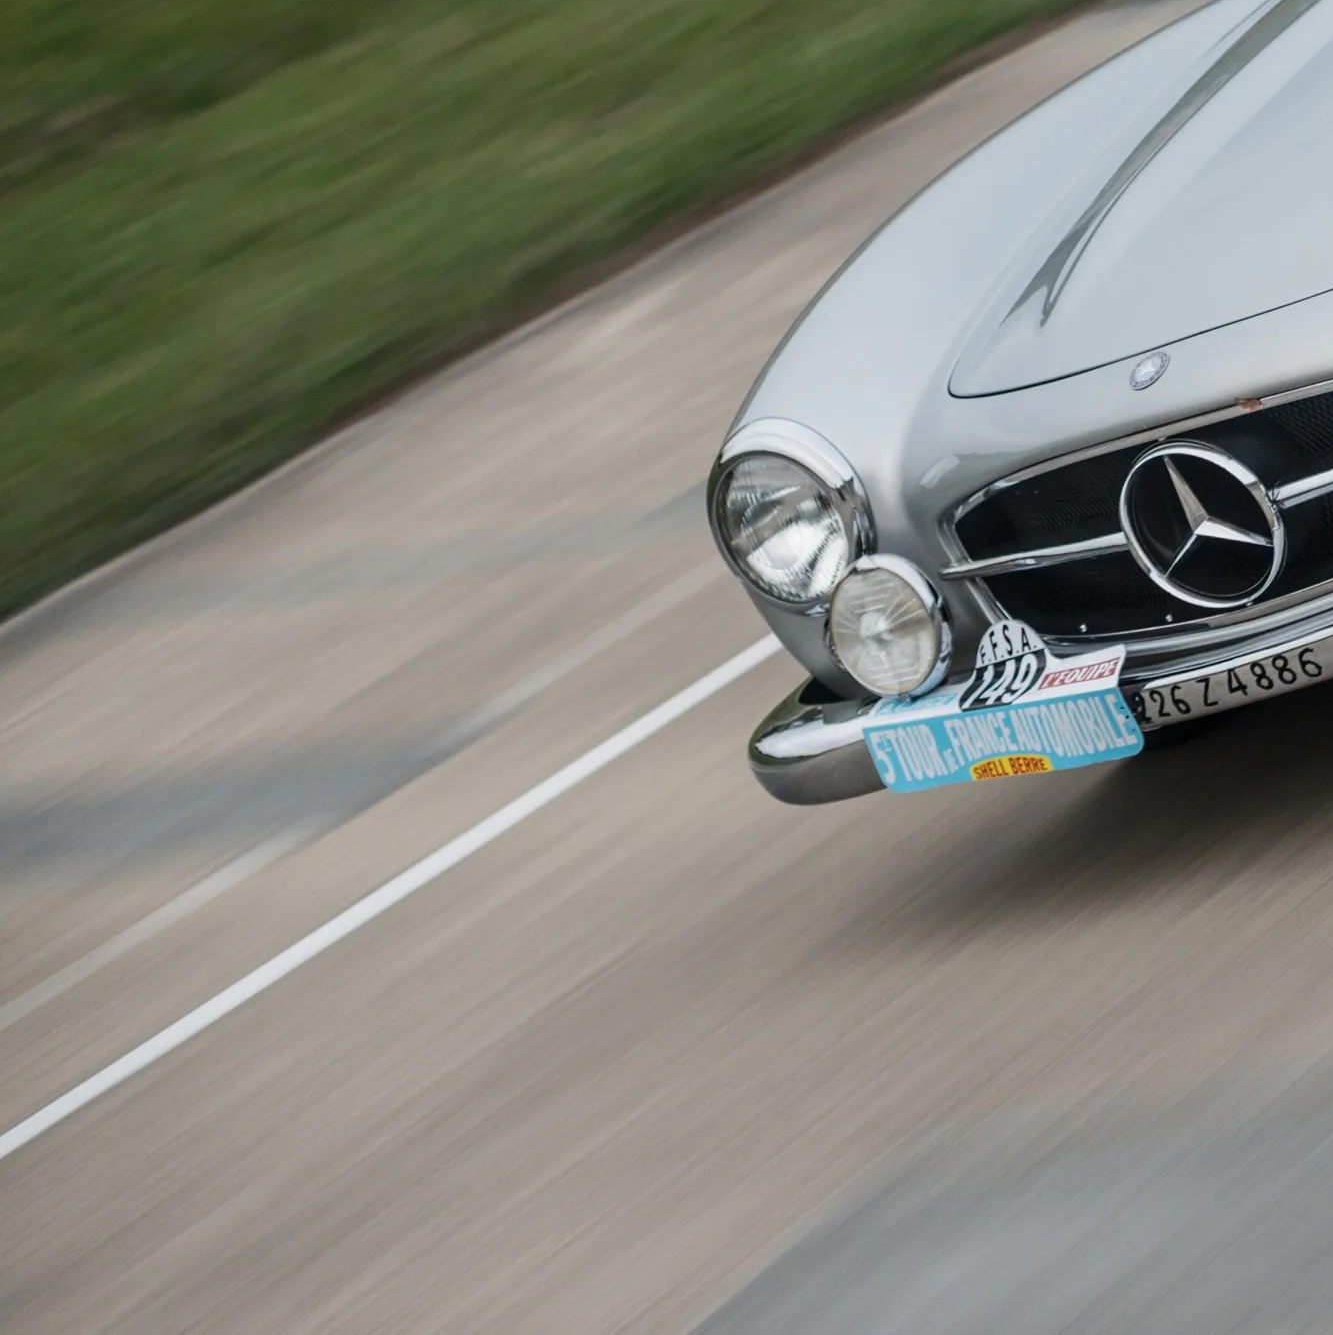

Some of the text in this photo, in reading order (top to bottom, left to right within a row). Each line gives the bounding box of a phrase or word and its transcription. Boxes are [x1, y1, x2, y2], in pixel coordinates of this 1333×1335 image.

[979, 624, 1037, 665] F.F.S.A.
[960, 653, 1038, 709] 149
[1195, 677, 1228, 707] Z
[1226, 647, 1323, 697] 4886
[886, 724, 949, 782] TOUR
[944, 711, 1018, 766] FRANCE
[1010, 694, 1139, 757] AUTOMOBILE
[973, 757, 1048, 780] SHELL BERRE
